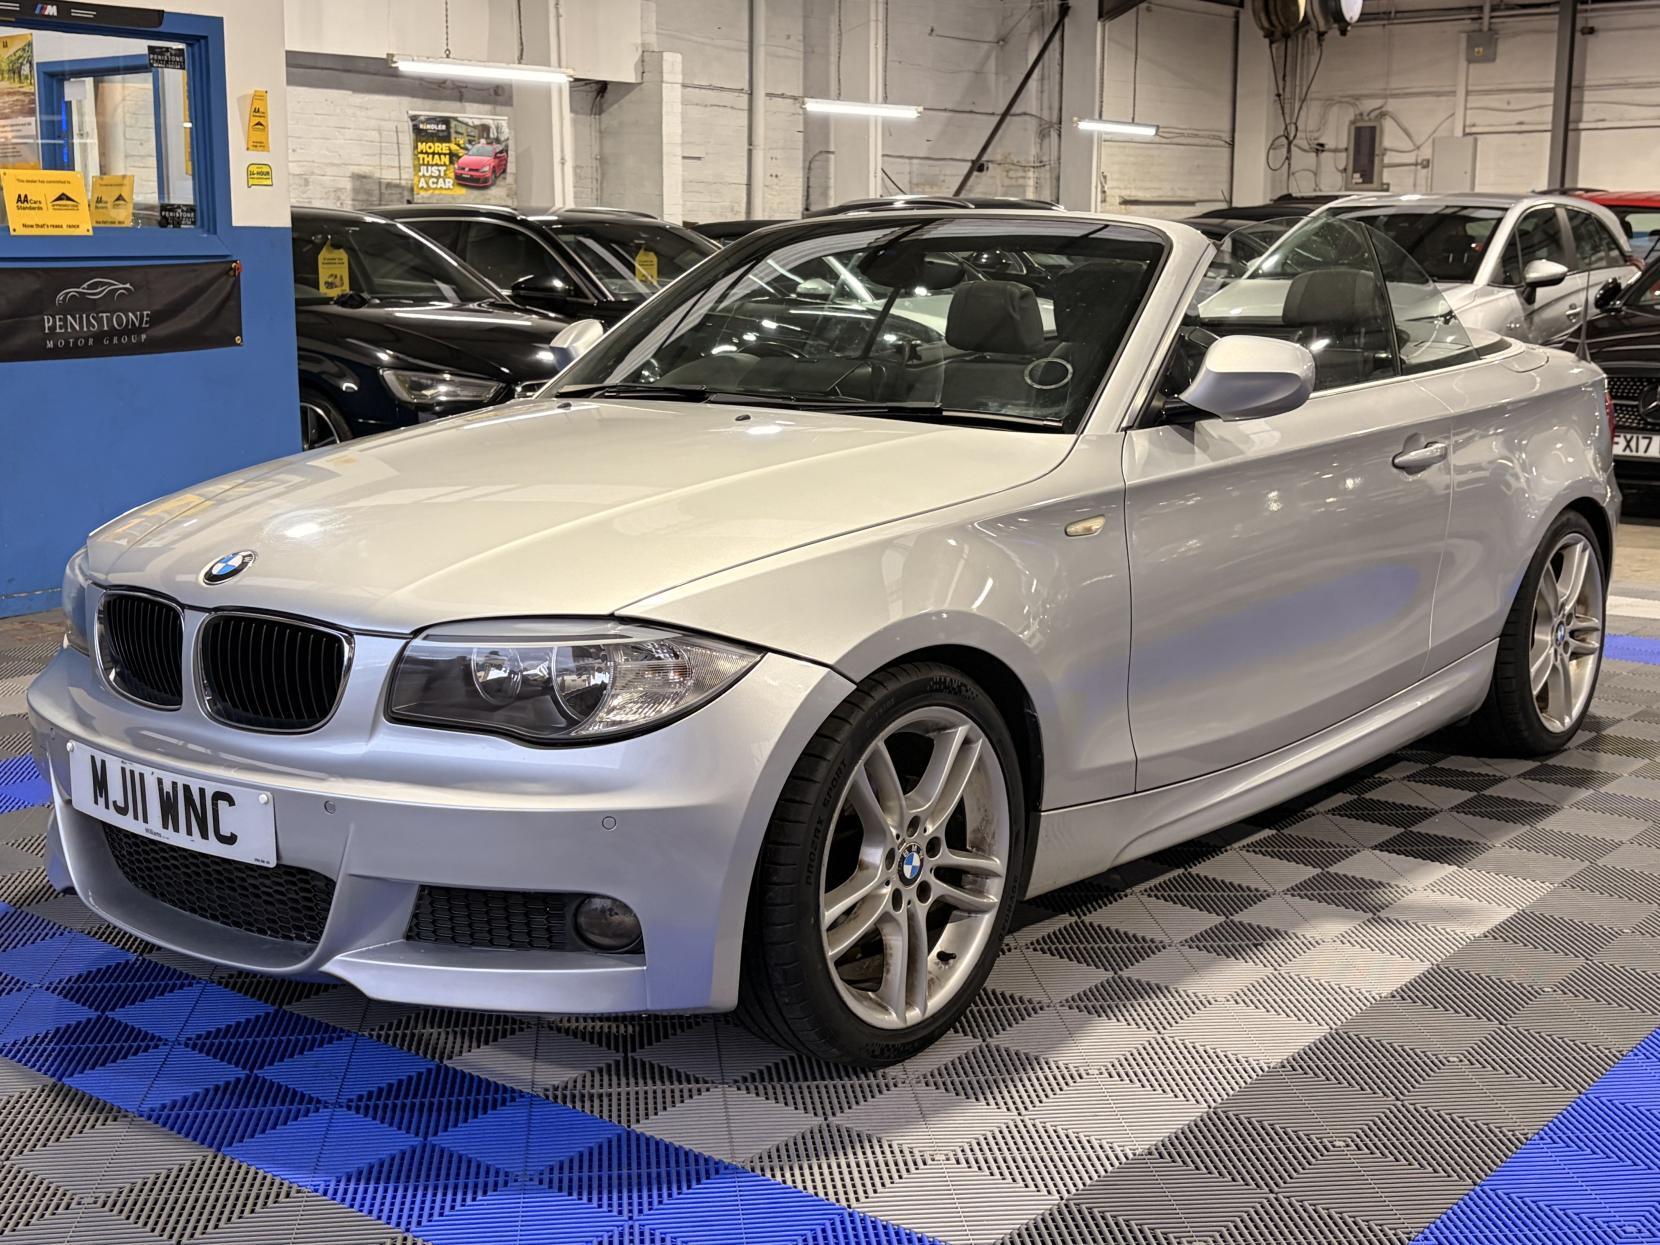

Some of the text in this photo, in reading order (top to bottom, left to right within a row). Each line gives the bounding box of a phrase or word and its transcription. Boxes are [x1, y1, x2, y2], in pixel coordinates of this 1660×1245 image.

[417, 143, 450, 153] MORE
[418, 154, 450, 165] THAN
[418, 166, 446, 177] JUST
[419, 178, 453, 189] A CAR
[16, 193, 29, 204] AA
[43, 311, 150, 333] PENISTONE
[46, 334, 148, 349] MOTOR GROUP
[90, 754, 238, 846] MJ11 WNC
